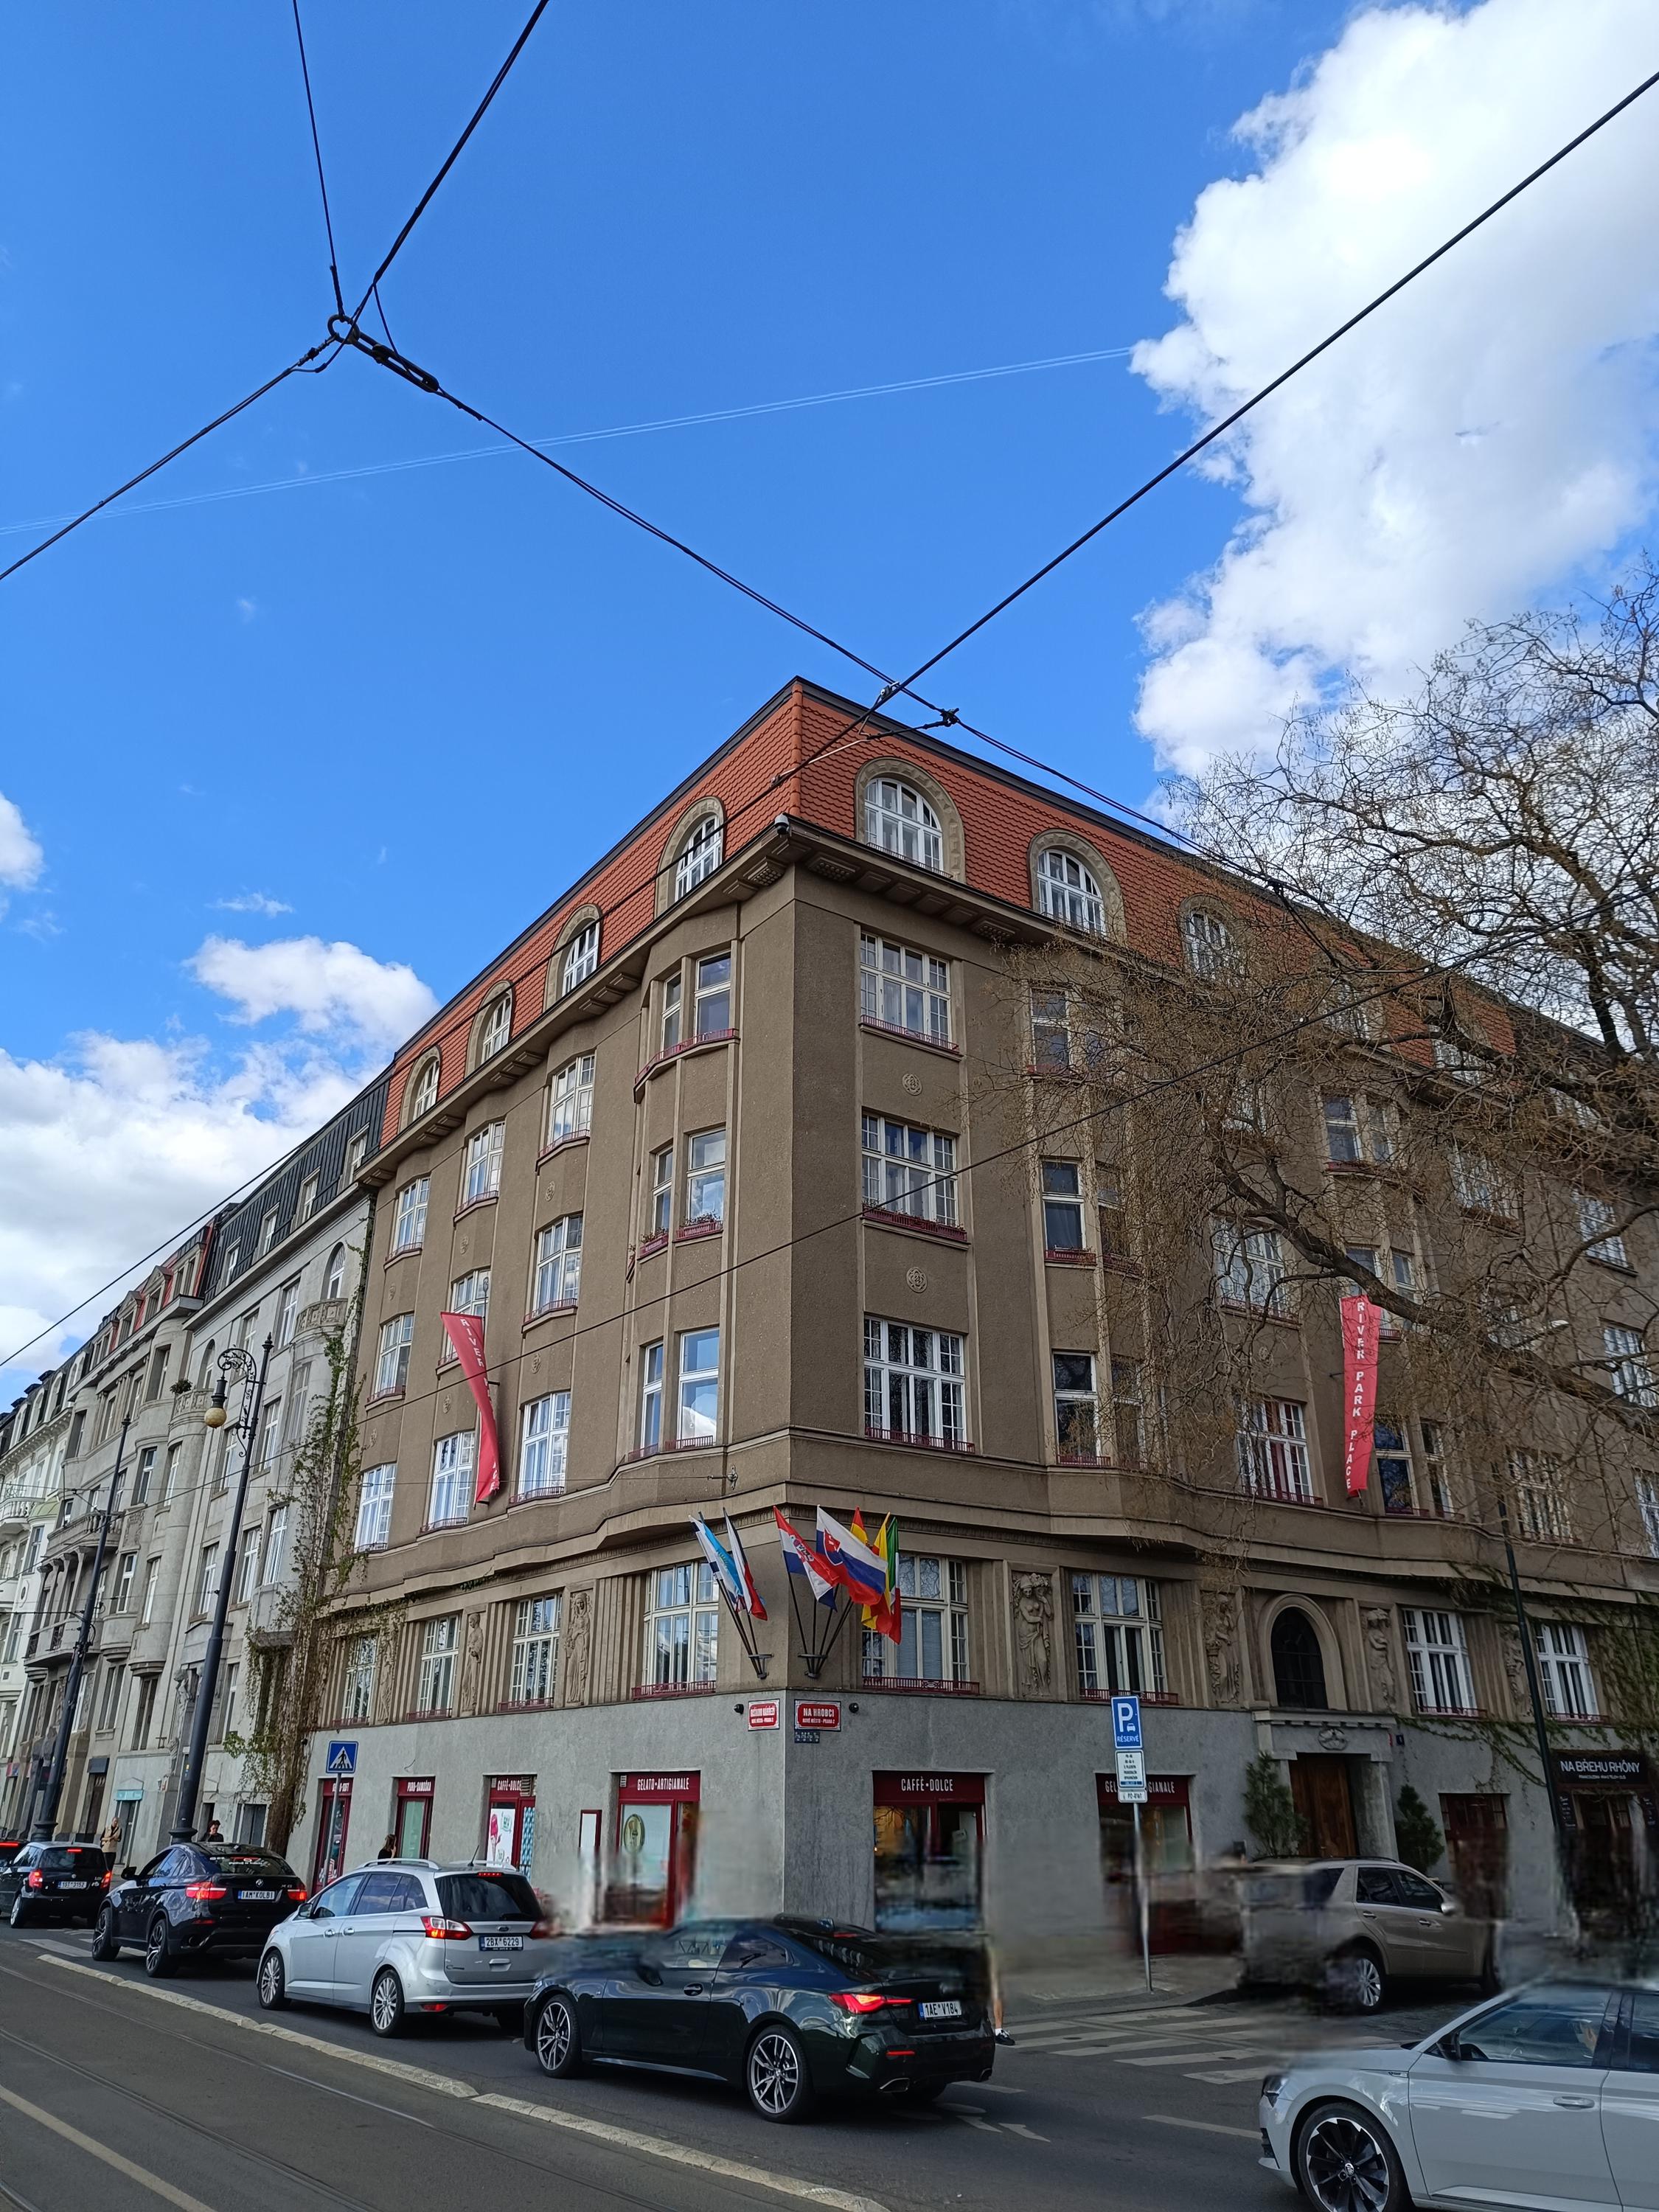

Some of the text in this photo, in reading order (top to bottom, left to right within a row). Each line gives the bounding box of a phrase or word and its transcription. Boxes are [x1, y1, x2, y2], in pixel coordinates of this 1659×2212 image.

[1346, 1301, 1366, 1489] RIVER PARK PLACE
[803, 1708, 835, 1717] NA HROBCI
[1117, 1734, 1139, 1742] RÉSERVÉ
[1560, 1759, 1639, 1773] NA BŘEHU RHÔNY
[487, 1937, 519, 1946] 2BX 6229
[925, 2004, 938, 2016] 1AE
